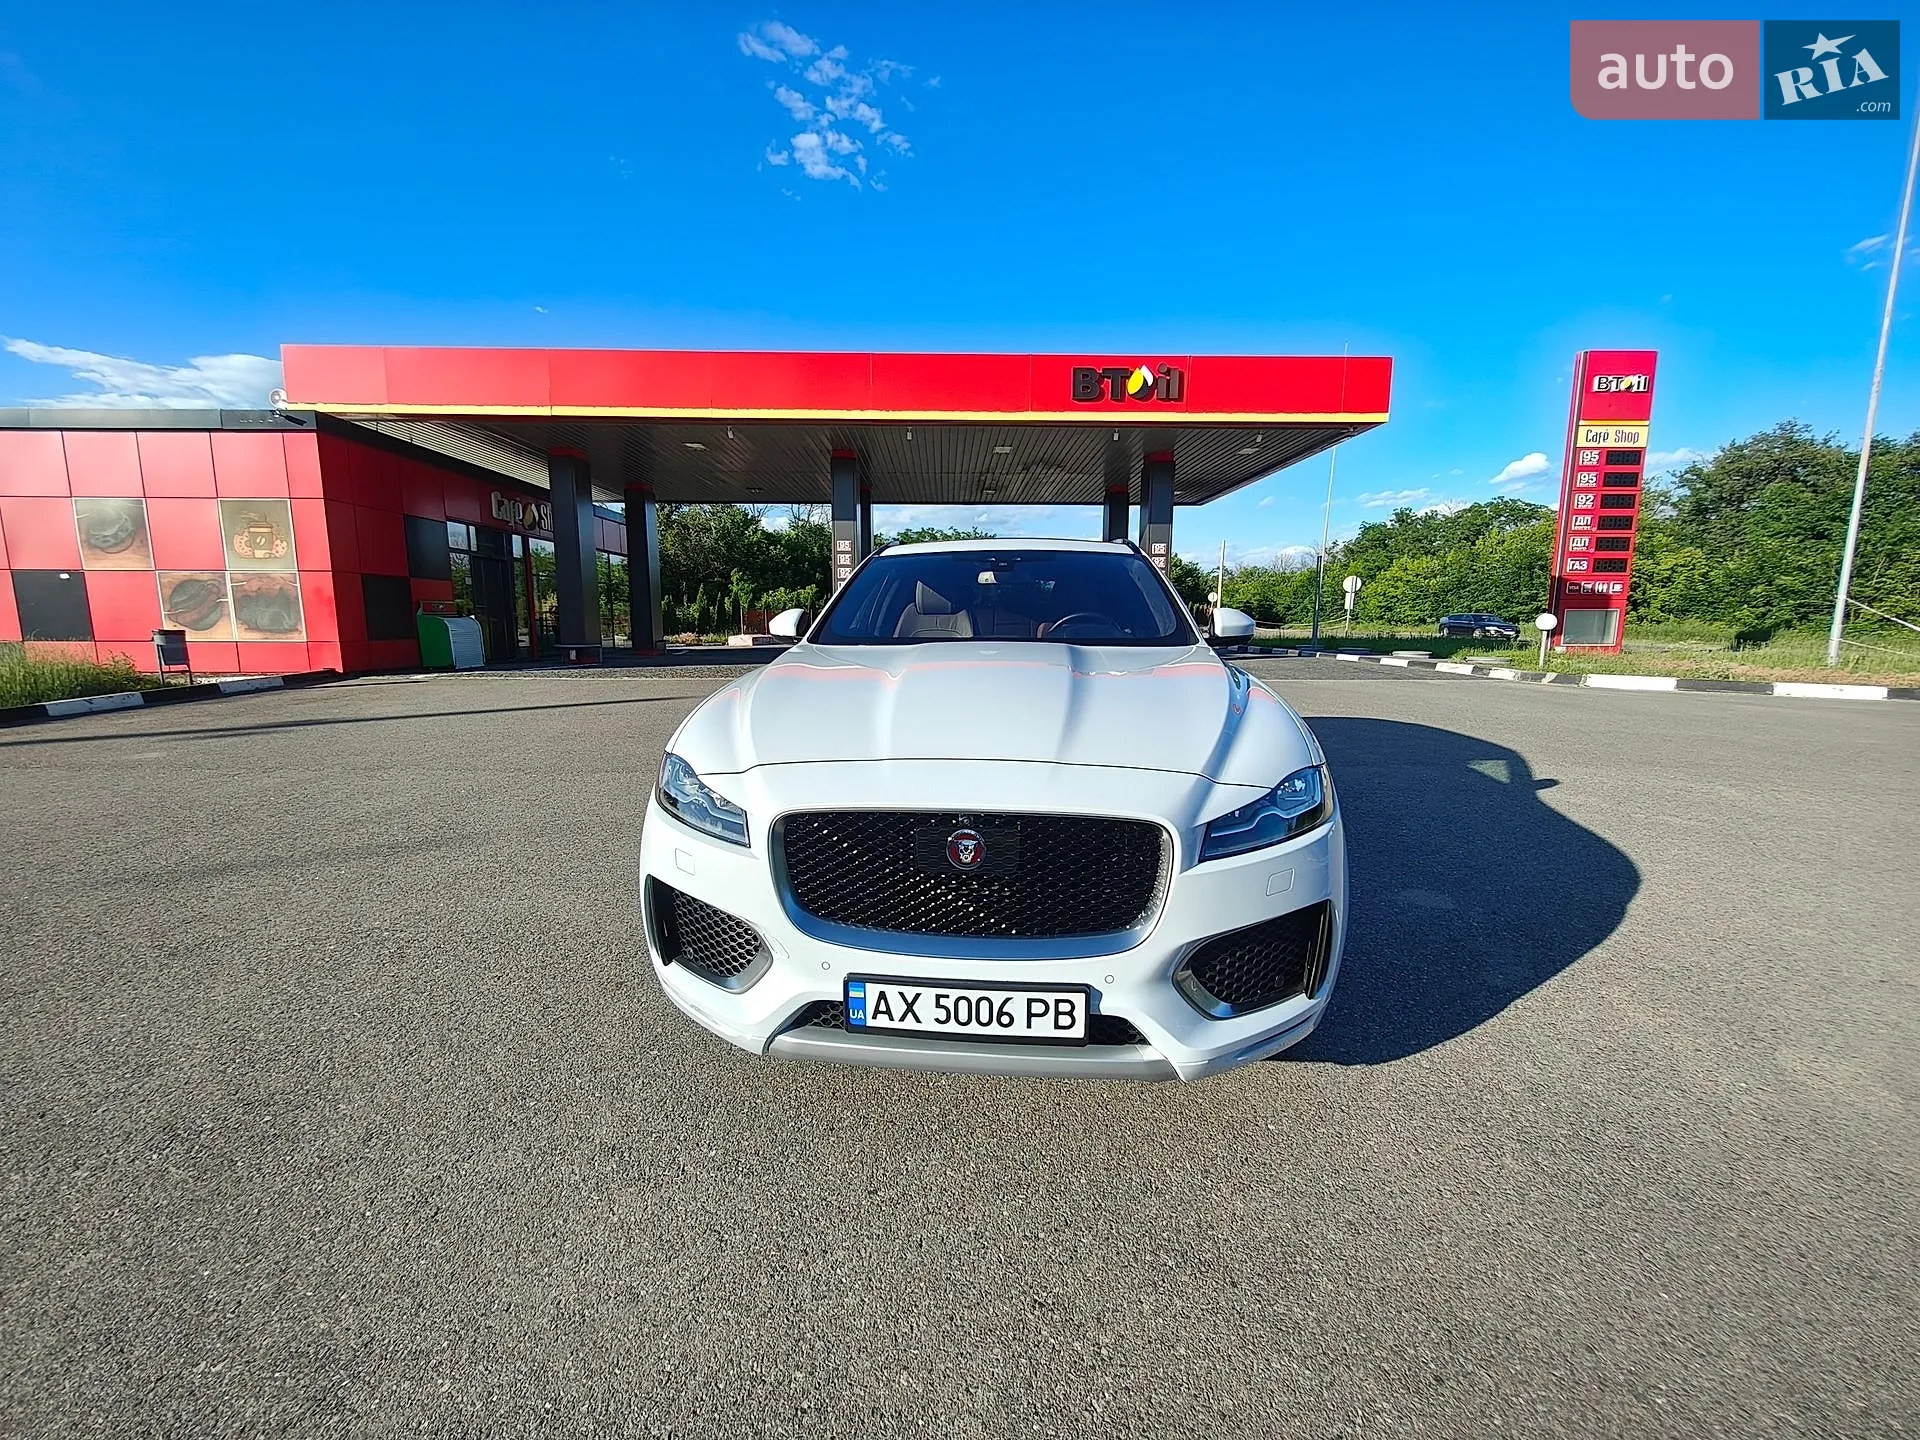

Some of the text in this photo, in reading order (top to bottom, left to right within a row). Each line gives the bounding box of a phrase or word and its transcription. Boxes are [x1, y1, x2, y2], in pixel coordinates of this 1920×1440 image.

[1614, 429, 1640, 445] Shop
[1583, 451, 1600, 462] 95
[1580, 473, 1597, 484] 95
[1577, 495, 1595, 505] 92
[1569, 561, 1588, 570] ГАЗ
[850, 990, 1077, 1030] UA AX 5006 PB
